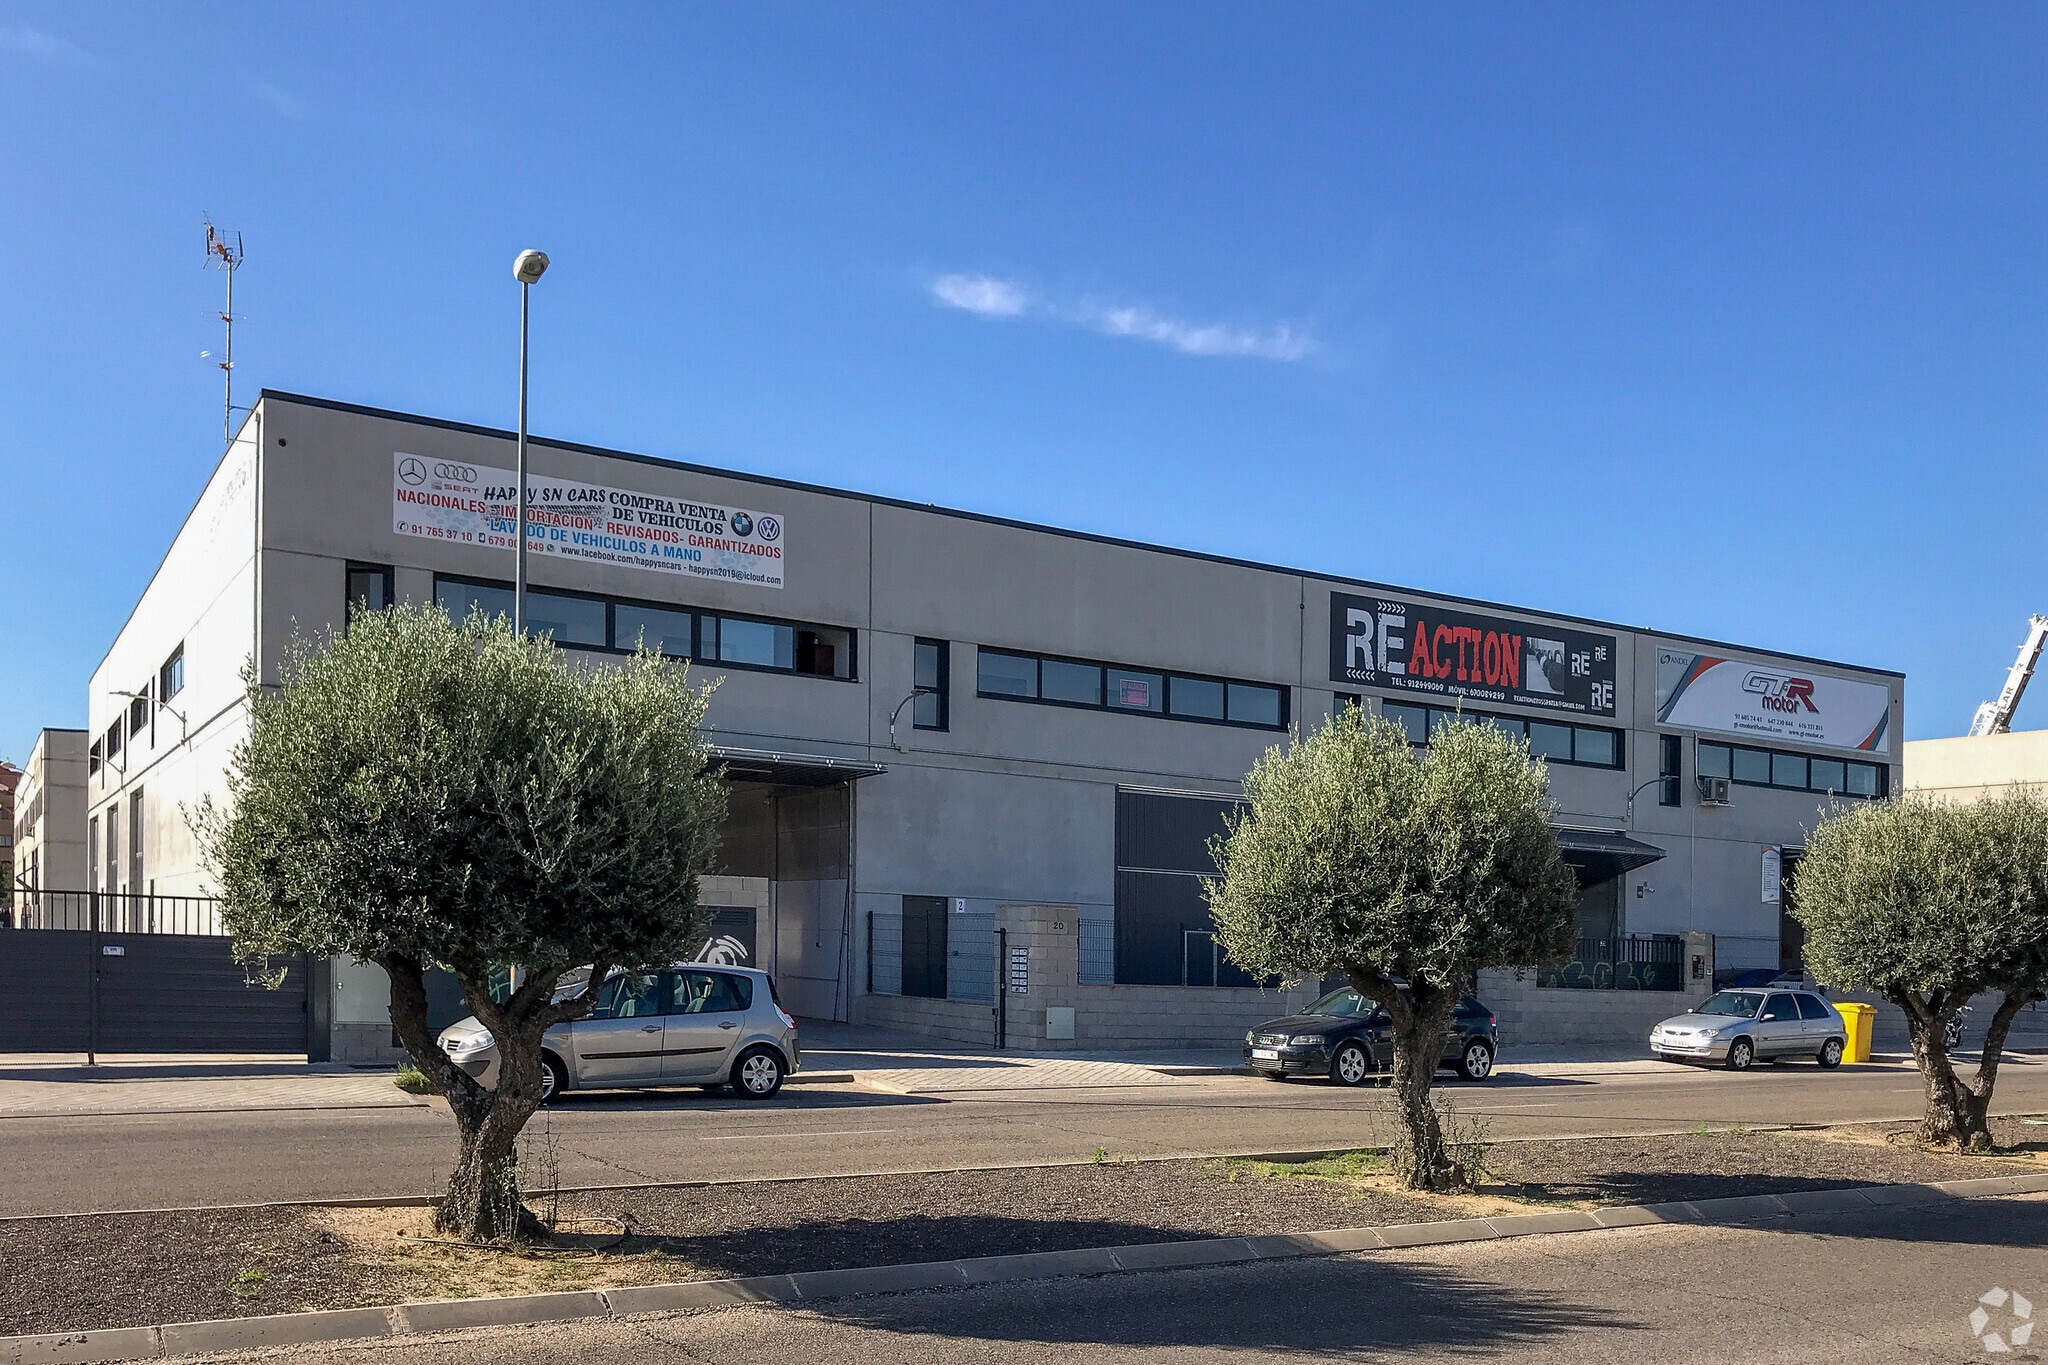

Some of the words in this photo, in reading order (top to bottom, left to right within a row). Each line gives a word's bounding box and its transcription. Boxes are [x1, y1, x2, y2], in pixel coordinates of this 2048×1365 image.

[444, 483, 479, 494] SEAT
[484, 486, 537, 503] HAPY
[542, 488, 563, 501] SN
[567, 488, 606, 502] CARS
[609, 491, 675, 514] COMPRA
[678, 502, 727, 522] VENTA
[397, 488, 486, 513] NACIONALES
[500, 504, 593, 530] IMORTACION
[688, 534, 781, 559] GARANTIZADOS
[612, 507, 633, 521] DE
[637, 510, 723, 535] VEHICULOS
[411, 524, 423, 534] 91
[427, 526, 444, 538] 765
[446, 529, 458, 539] 37
[461, 531, 472, 541] 10
[490, 519, 545, 538] LAVDO
[550, 529, 568, 542] DE
[572, 531, 646, 554] VEHICULOS
[651, 545, 660, 556] A
[664, 547, 702, 562] MANO
[488, 535, 506, 547] 679
[527, 541, 544, 552] 649
[560, 546, 682, 571] www.facebook.com/happysncars
[688, 563, 781, 585] happysn2019@icloud.com
[1594, 646, 1607, 661] RE
[1571, 652, 1591, 676] RE
[1391, 677, 1406, 687] TEL:
[1591, 682, 1613, 709] RE
[1762, 695, 1800, 714] motor
[958, 900, 963, 910] 2
[1053, 921, 1064, 930] 20
